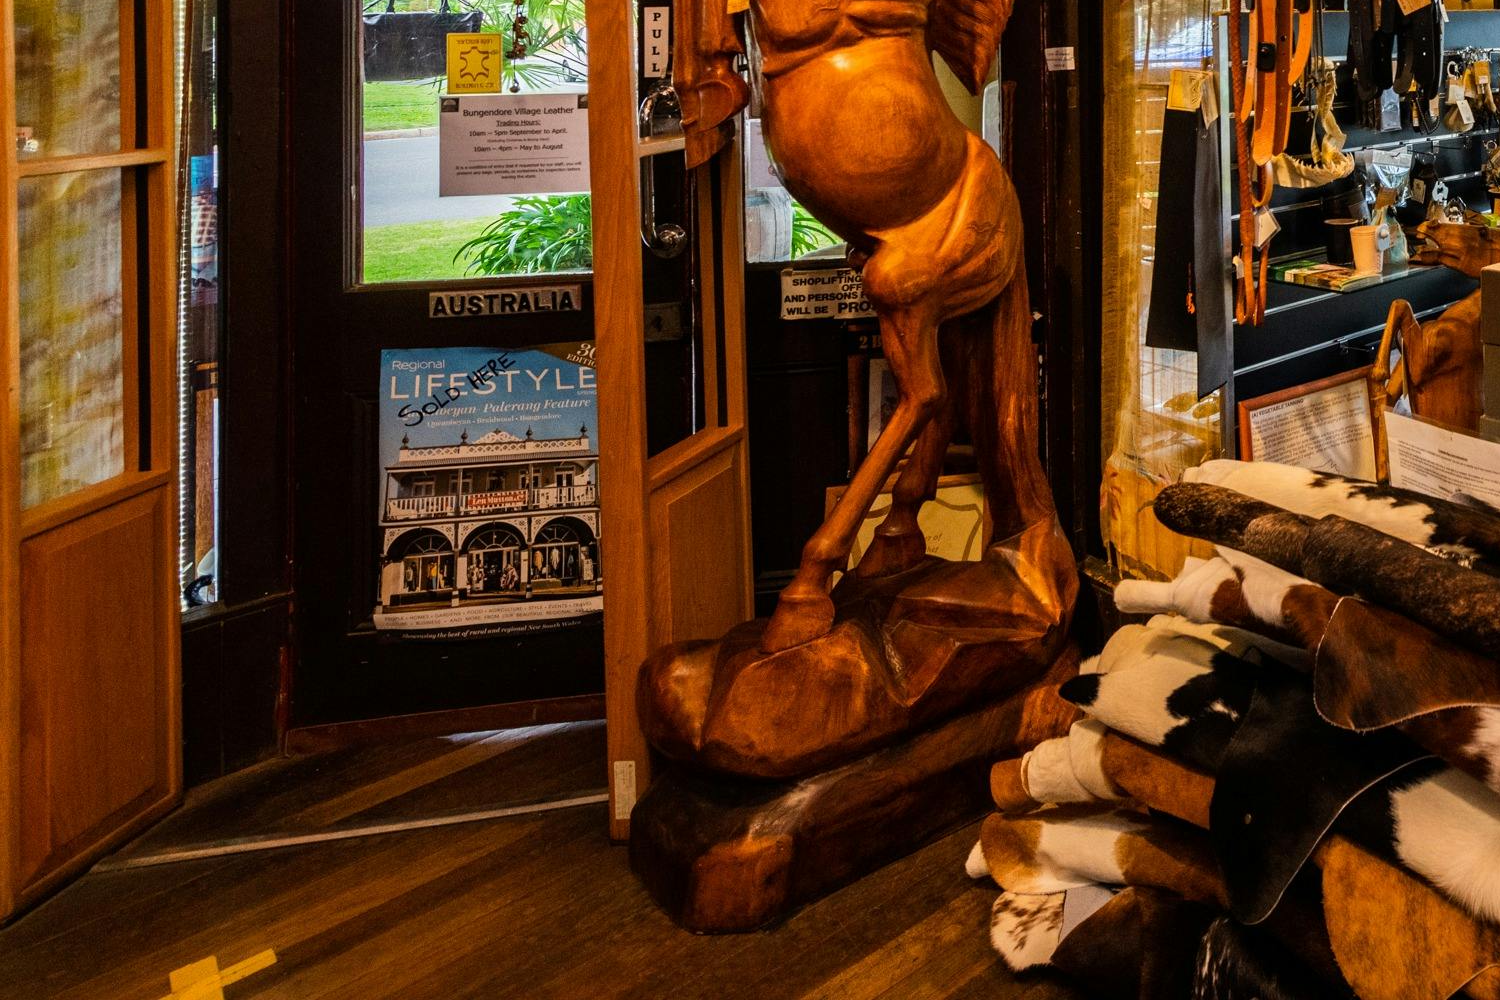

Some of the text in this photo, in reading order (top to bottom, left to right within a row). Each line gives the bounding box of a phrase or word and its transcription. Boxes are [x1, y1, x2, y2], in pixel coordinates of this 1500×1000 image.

[650, 11, 662, 74] PULL
[463, 106, 574, 118] Bungendore Village Leather
[792, 275, 863, 287] SHOPLIFTING
[432, 291, 574, 316] AUSTRALIA
[784, 291, 858, 303] AND PERSONS
[787, 306, 829, 315] WILL BE
[392, 360, 445, 372] Regional
[466, 352, 517, 389] HERE
[390, 366, 597, 400] LIFESTYLE
[483, 398, 591, 415] Palerang Feature
